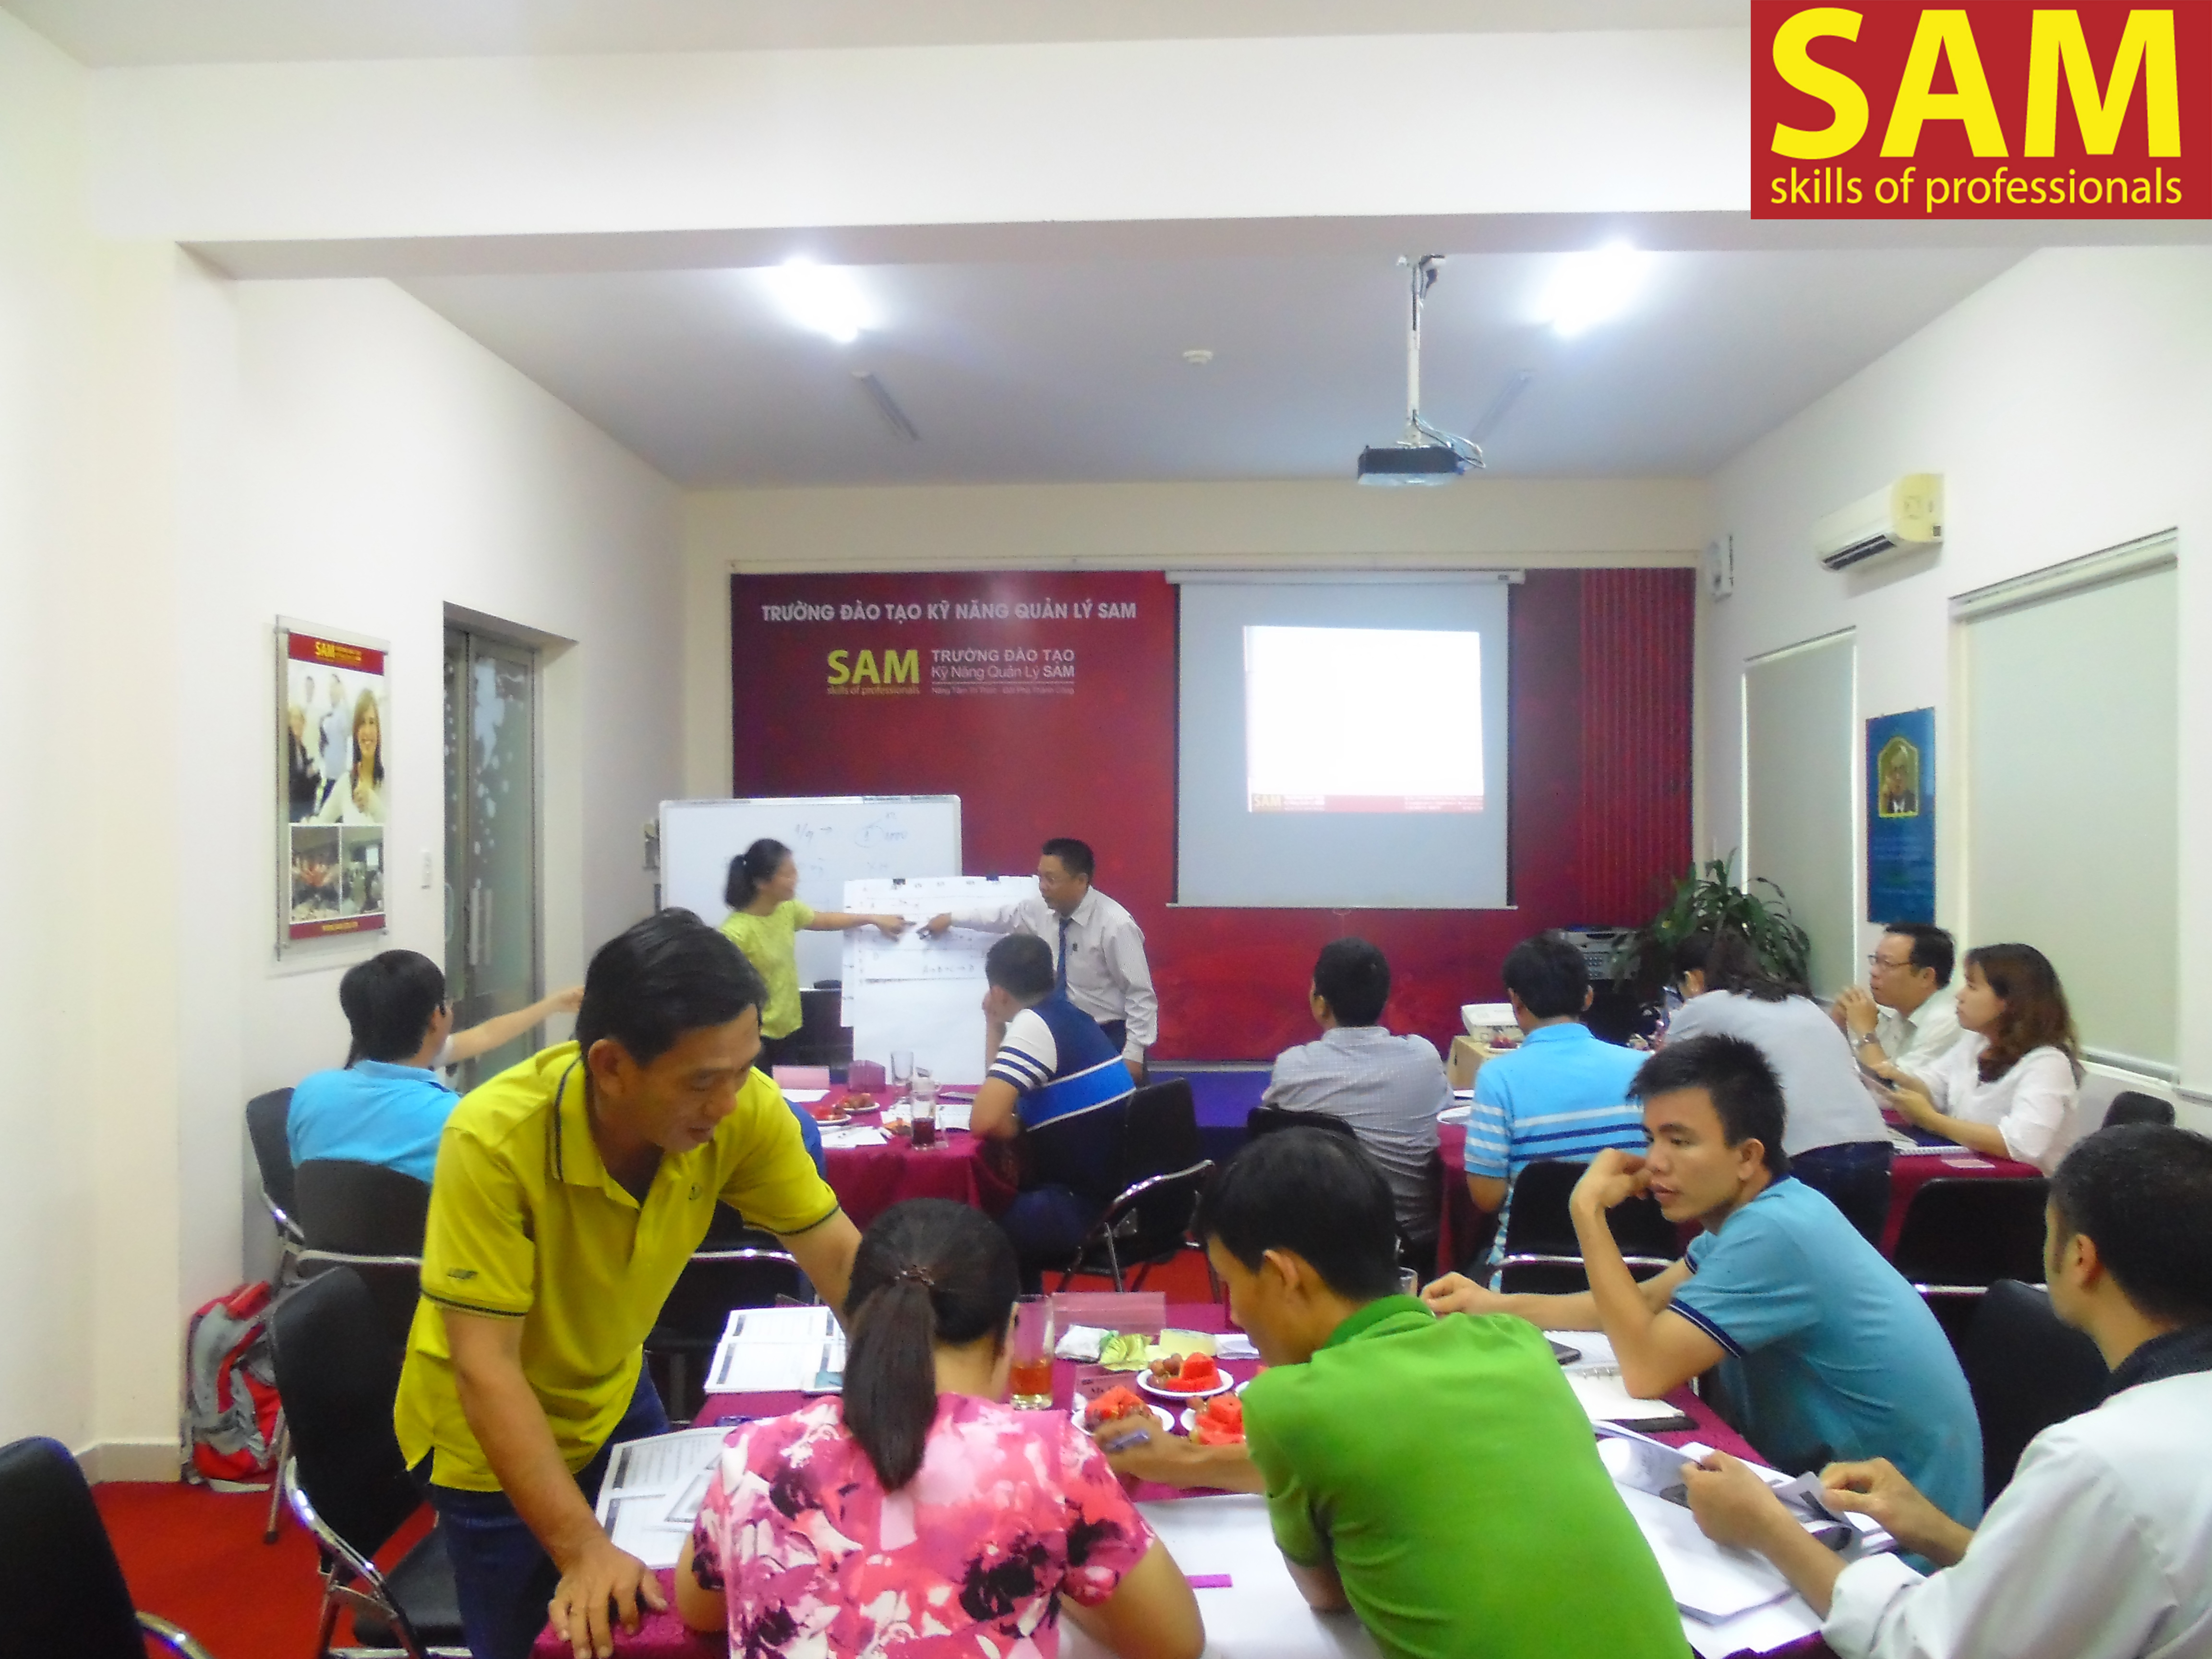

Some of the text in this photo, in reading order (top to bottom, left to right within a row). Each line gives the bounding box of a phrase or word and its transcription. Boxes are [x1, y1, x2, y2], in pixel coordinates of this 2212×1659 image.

[761, 597, 1137, 625] TRƯỜNG ĐÀO TẠO KỸ NĂNG QUẢN LÝ SAM
[931, 647, 999, 662] TRƯỜNG
[1004, 647, 1038, 662] ĐÀO
[827, 649, 920, 685] SAM
[1043, 665, 1075, 677] SAM
[1254, 794, 1282, 807] SAM
